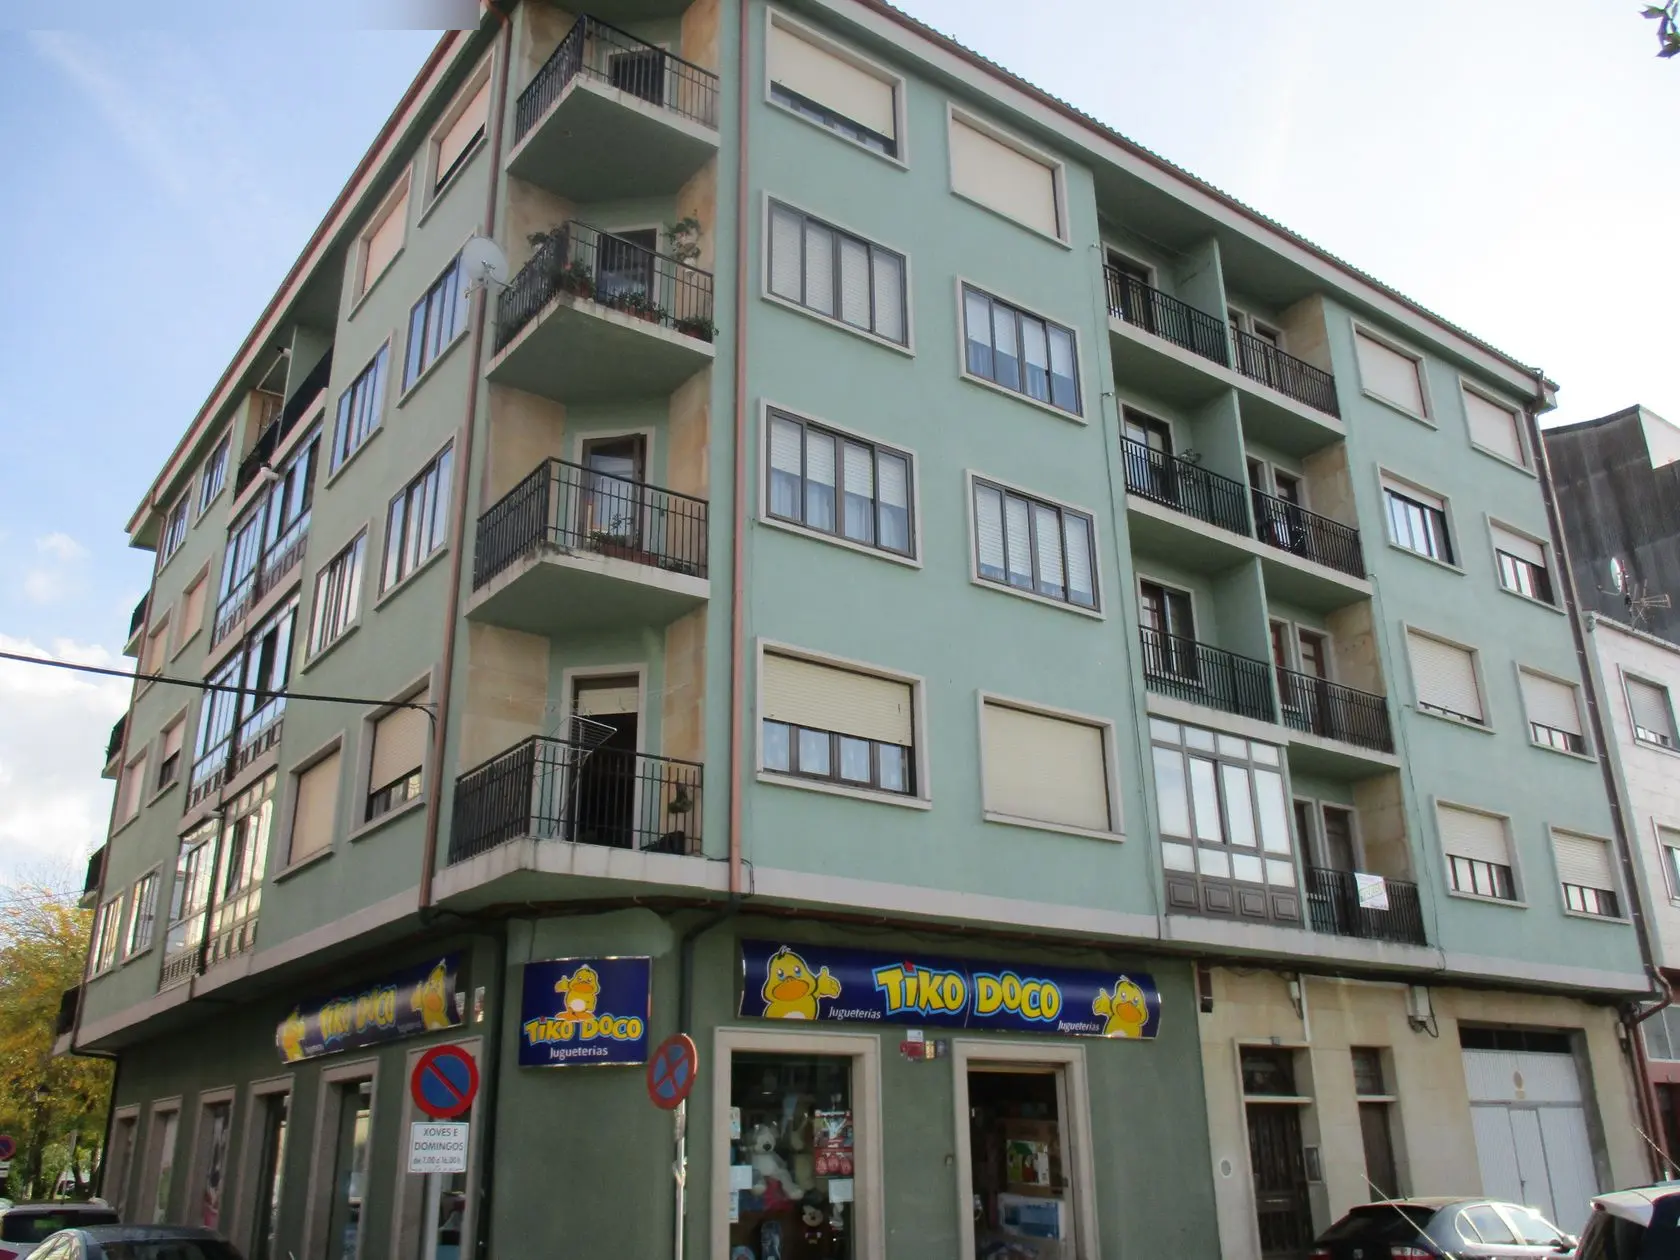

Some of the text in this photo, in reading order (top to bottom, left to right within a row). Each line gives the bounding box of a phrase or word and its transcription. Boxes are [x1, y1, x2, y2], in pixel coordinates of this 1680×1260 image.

[973, 970, 1062, 1022] DOCO
[579, 1013, 643, 1040] DOCO
[423, 1127, 458, 1137] XOVES E
[414, 1141, 464, 1151] DOMINGOS
